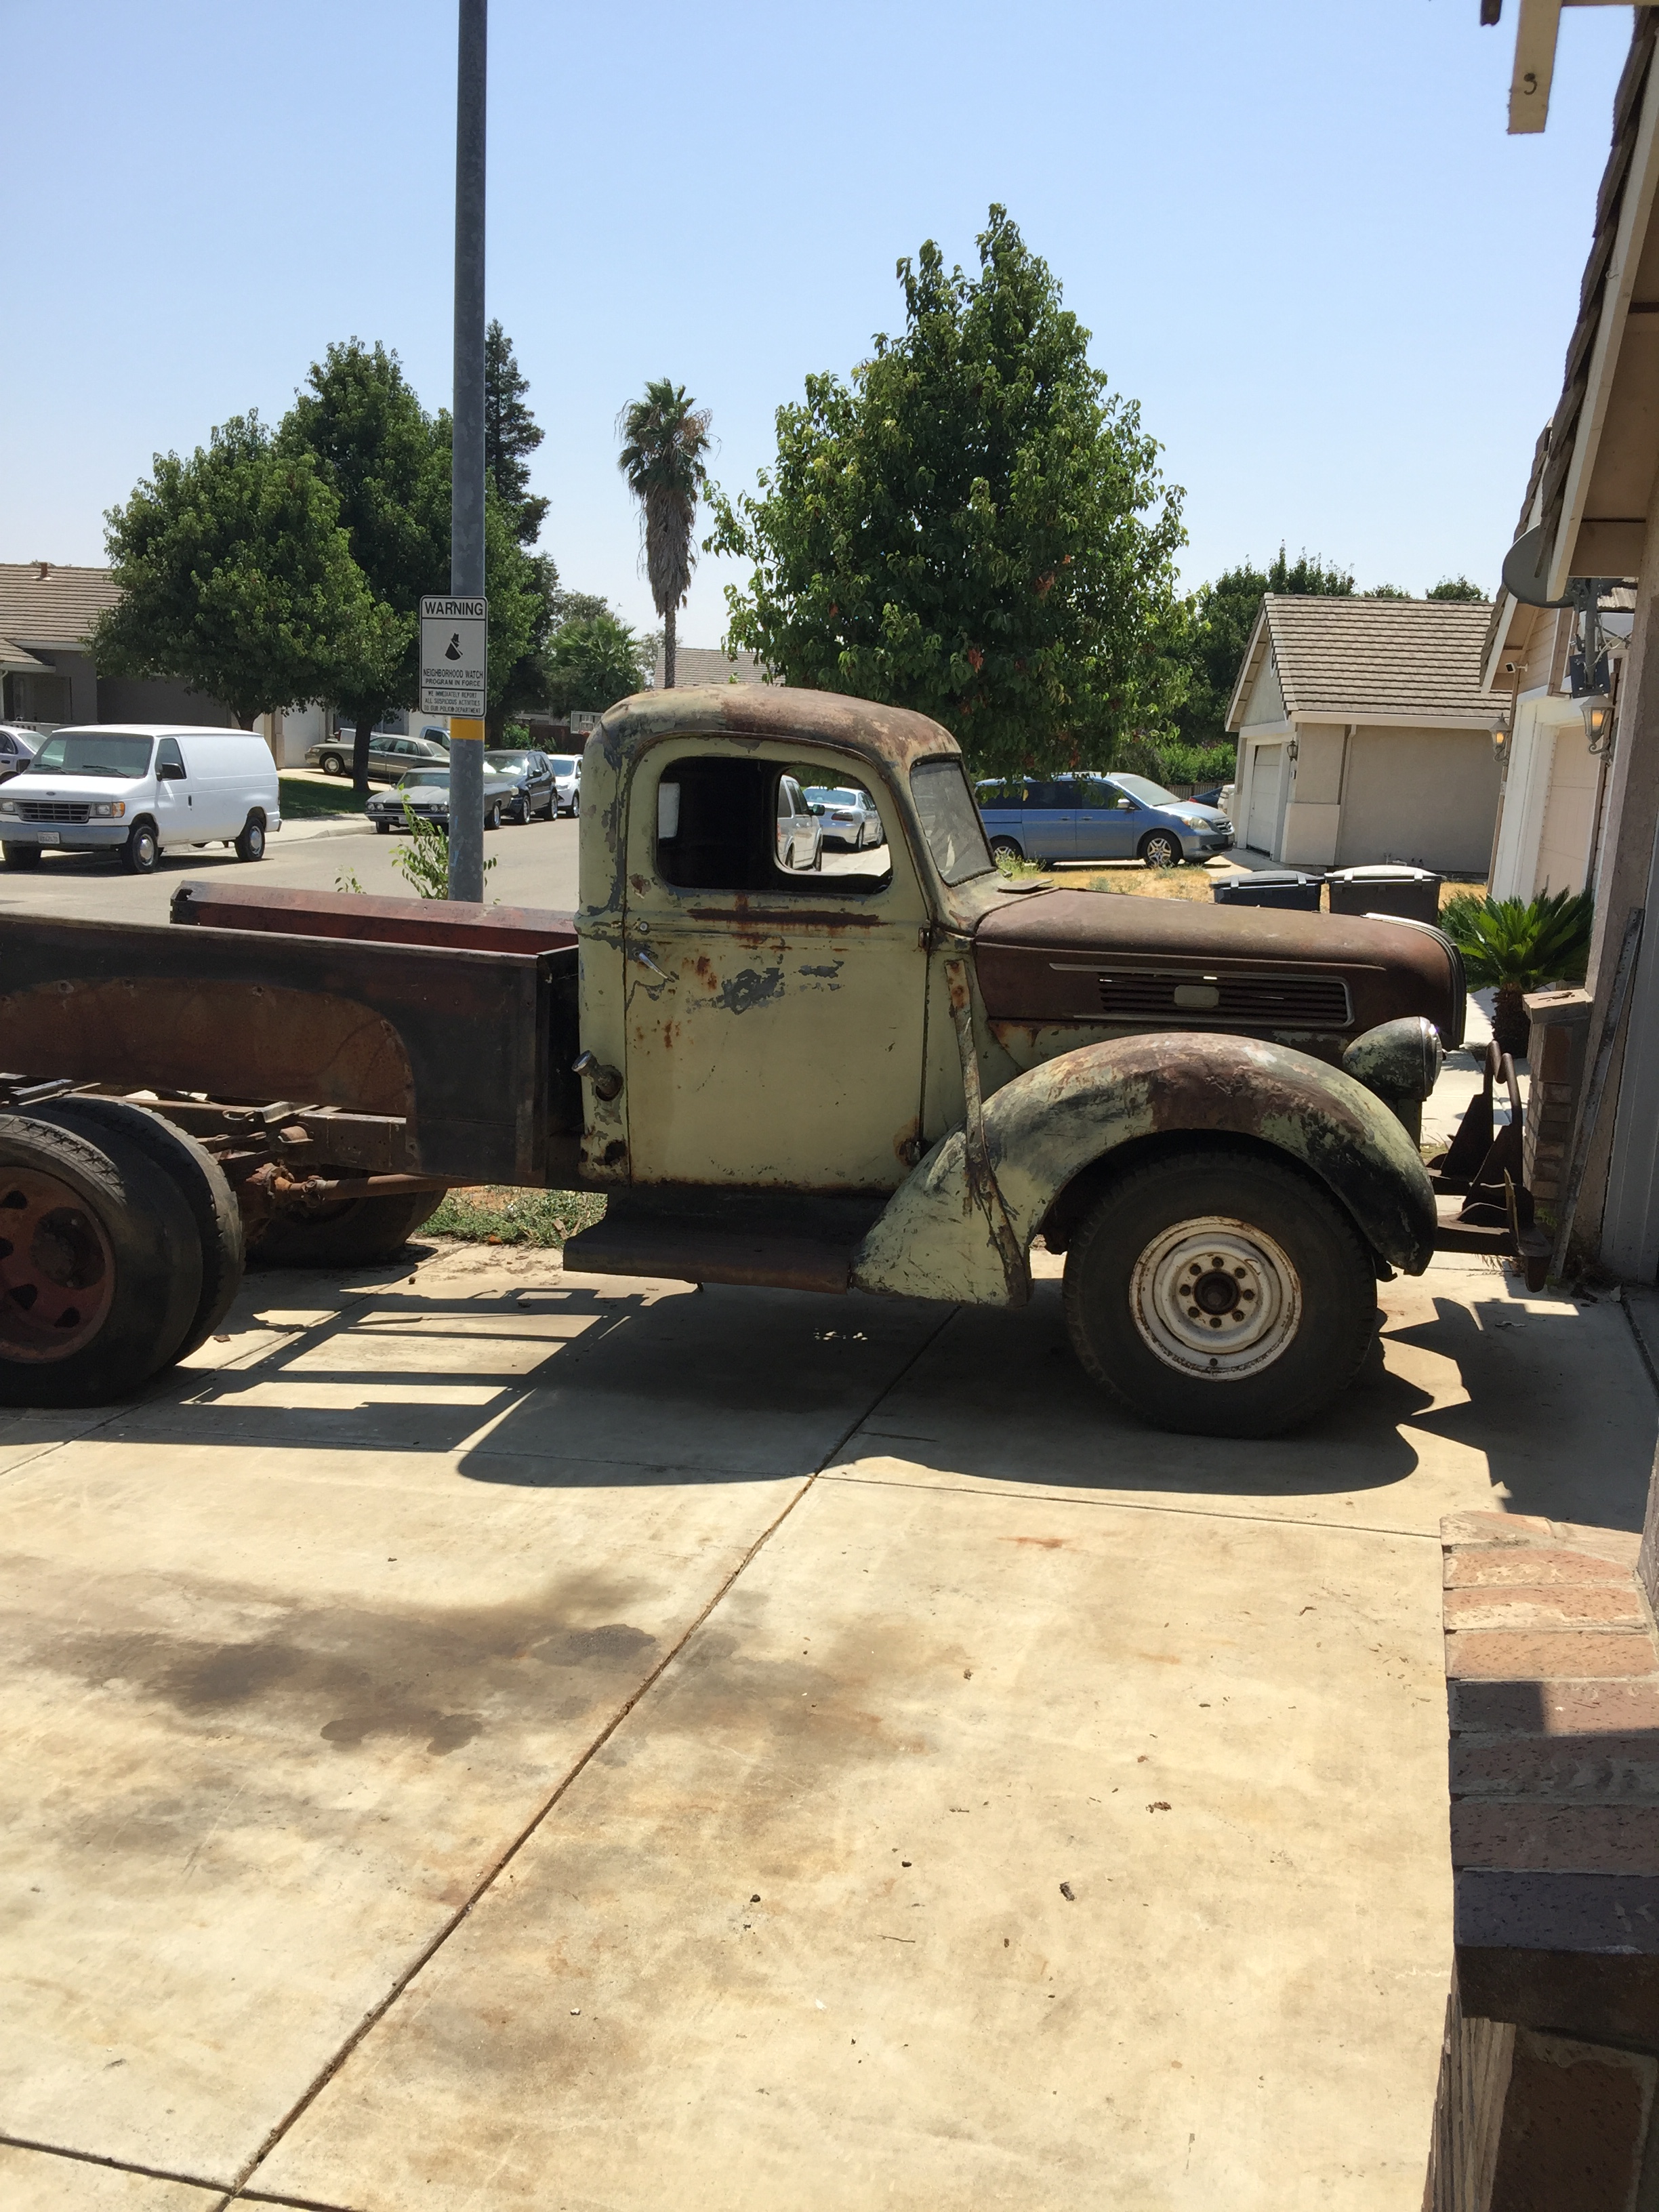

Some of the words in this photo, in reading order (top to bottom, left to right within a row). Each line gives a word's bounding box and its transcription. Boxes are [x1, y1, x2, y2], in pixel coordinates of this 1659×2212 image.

[425, 602, 483, 615] WARNING
[424, 669, 464, 678] NEIGHBORHOOD
[466, 670, 483, 678] WATCH
